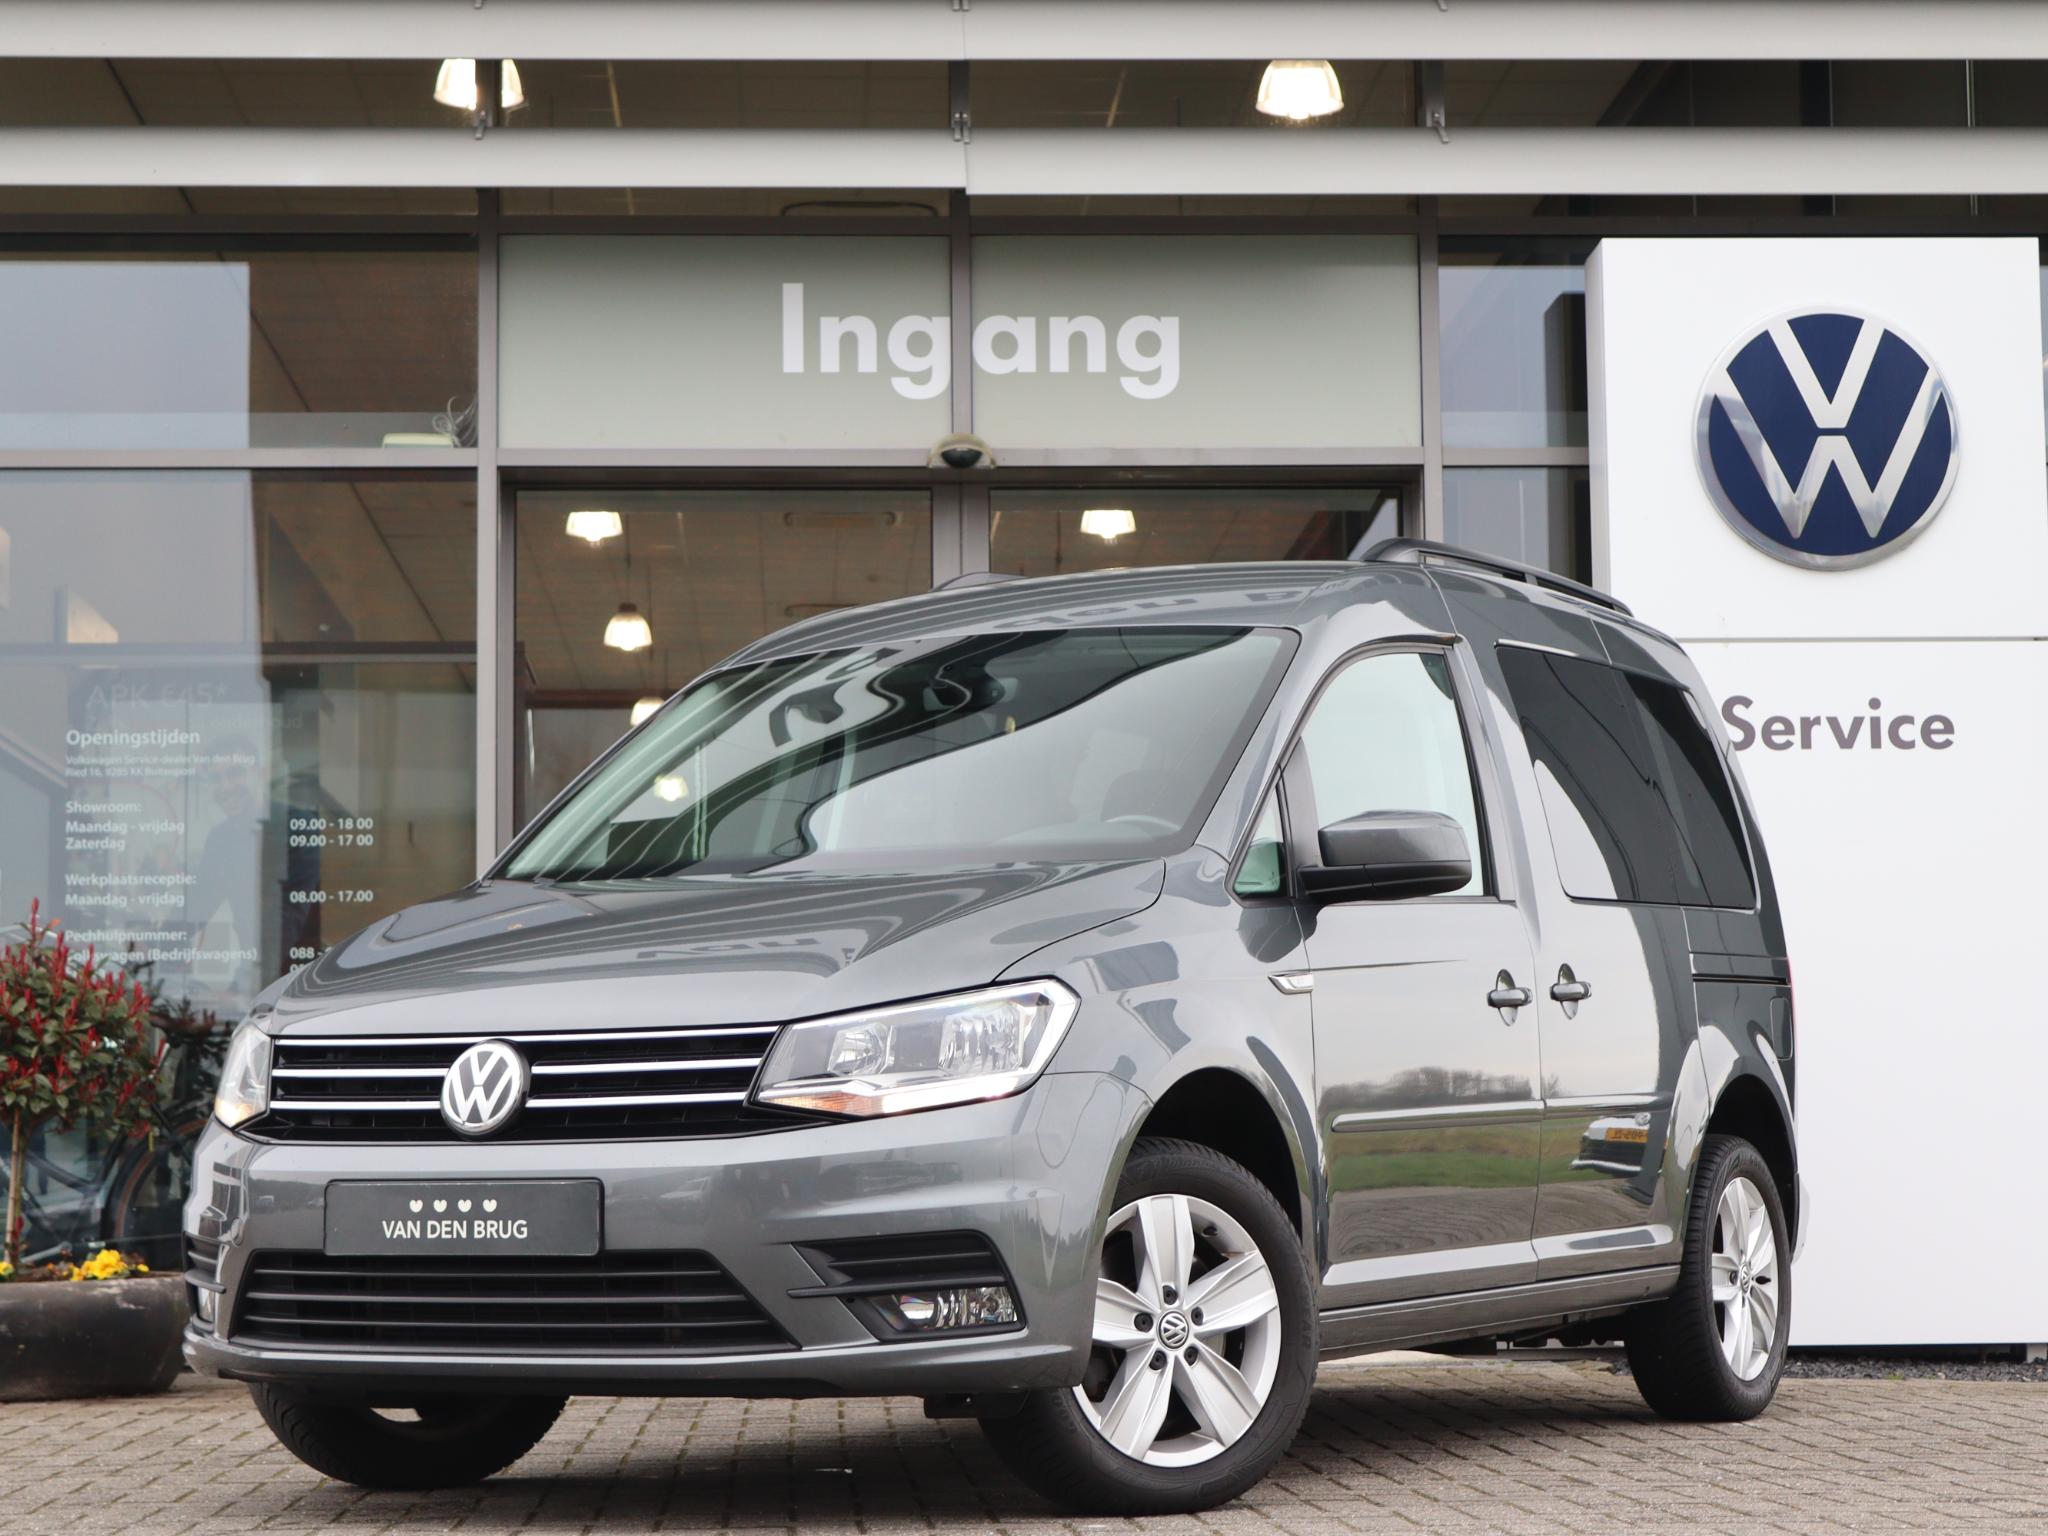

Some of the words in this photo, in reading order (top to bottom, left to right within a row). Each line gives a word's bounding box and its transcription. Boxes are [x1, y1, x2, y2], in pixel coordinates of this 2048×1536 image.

[782, 283, 1180, 399] Ingang
[1721, 695, 1955, 751] Service
[66, 729, 201, 748] Openingstijden
[65, 801, 142, 815] Showroom:
[65, 820, 128, 835] Maandag
[138, 820, 185, 835] vrijdag
[290, 817, 327, 831] 09.00
[65, 837, 126, 852] Zaterdag
[290, 834, 327, 847] 09.00
[65, 873, 197, 888] Werkplaatsreceptie:
[65, 894, 128, 909] Maandag
[138, 893, 185, 908] vrijdag
[290, 890, 327, 903] 08.00
[338, 889, 374, 902] 17.00
[65, 930, 188, 943] Pechhulpnummer:
[147, 947, 258, 964] (Bedrijfswagens)
[290, 946, 316, 960] 088
[382, 1220, 421, 1239] VAN
[427, 1220, 467, 1239] DEN
[474, 1219, 528, 1239] BRUG
